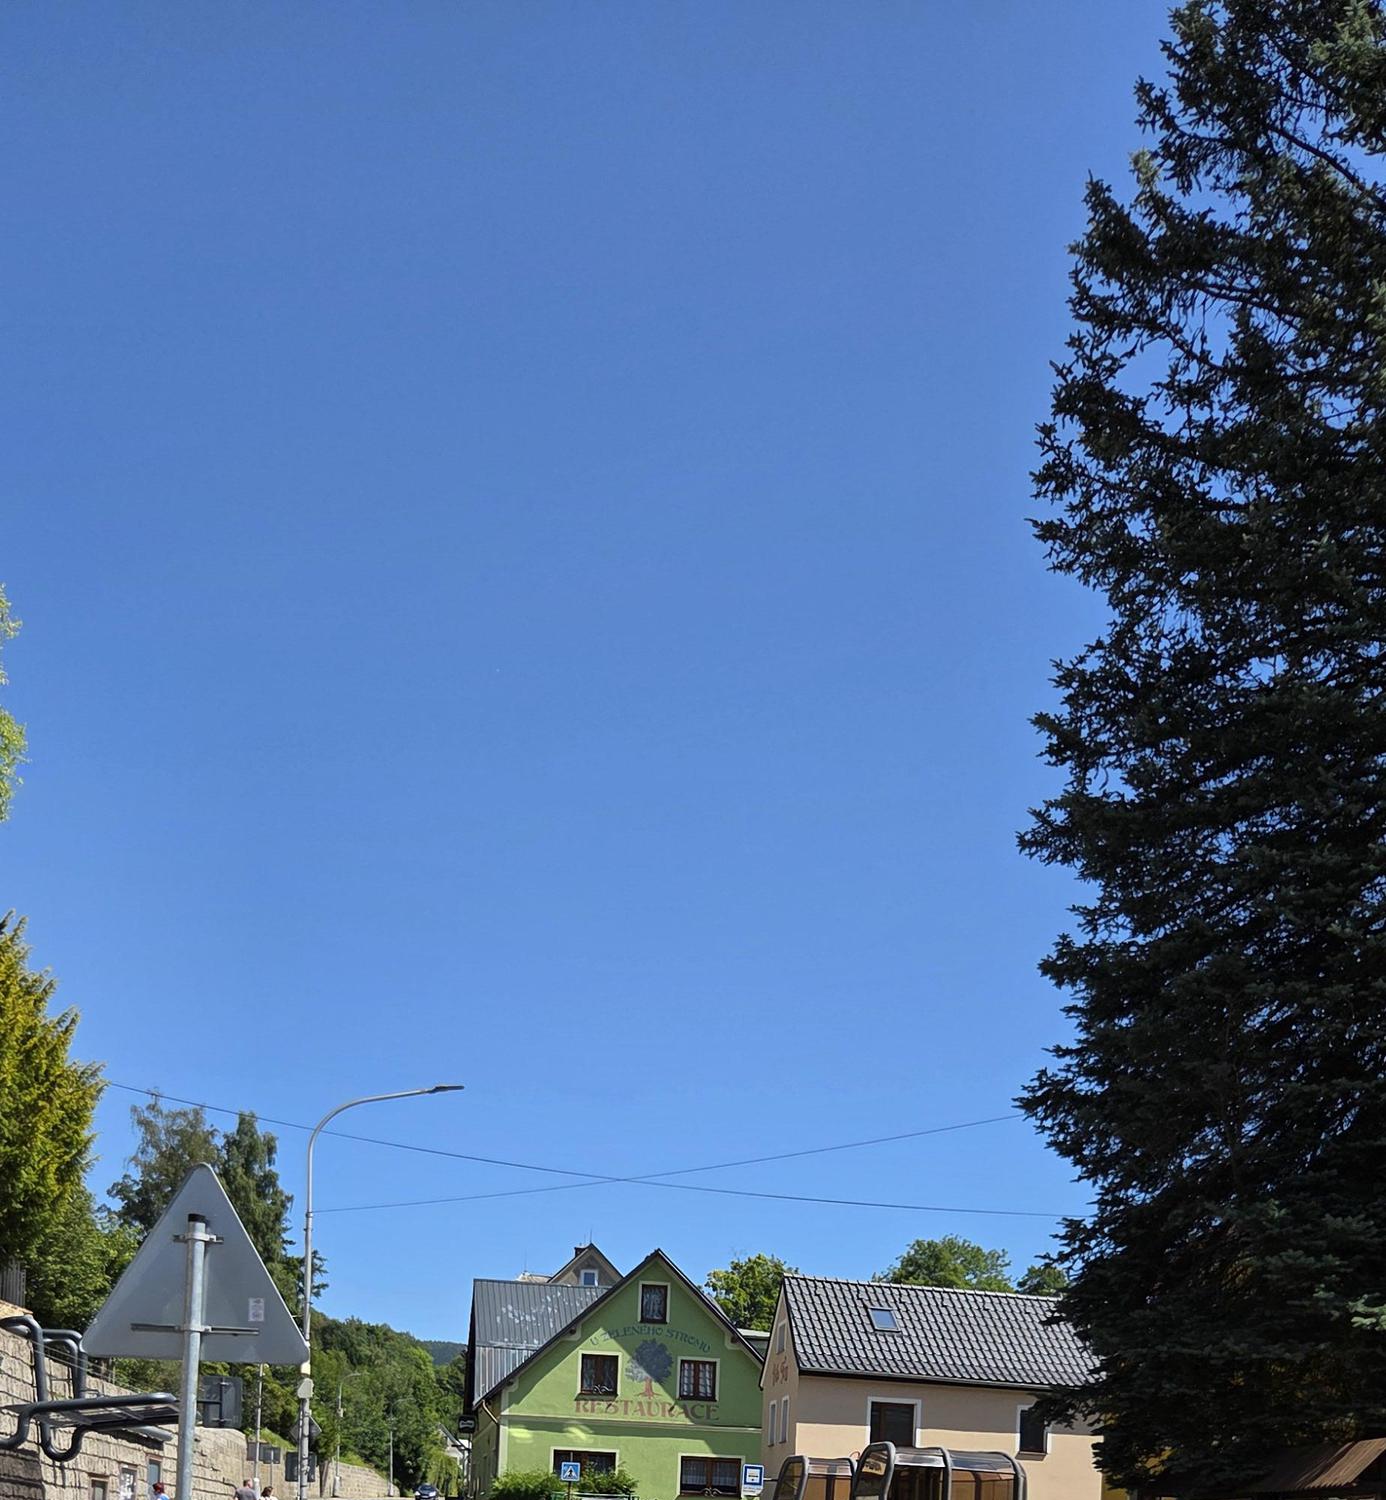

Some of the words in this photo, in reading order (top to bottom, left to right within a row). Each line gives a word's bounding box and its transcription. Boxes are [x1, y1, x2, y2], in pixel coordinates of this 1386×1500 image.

[590, 1337, 599, 1346] U
[666, 1329, 711, 1353] STROMU
[575, 1399, 720, 1420] RESTAURACE
